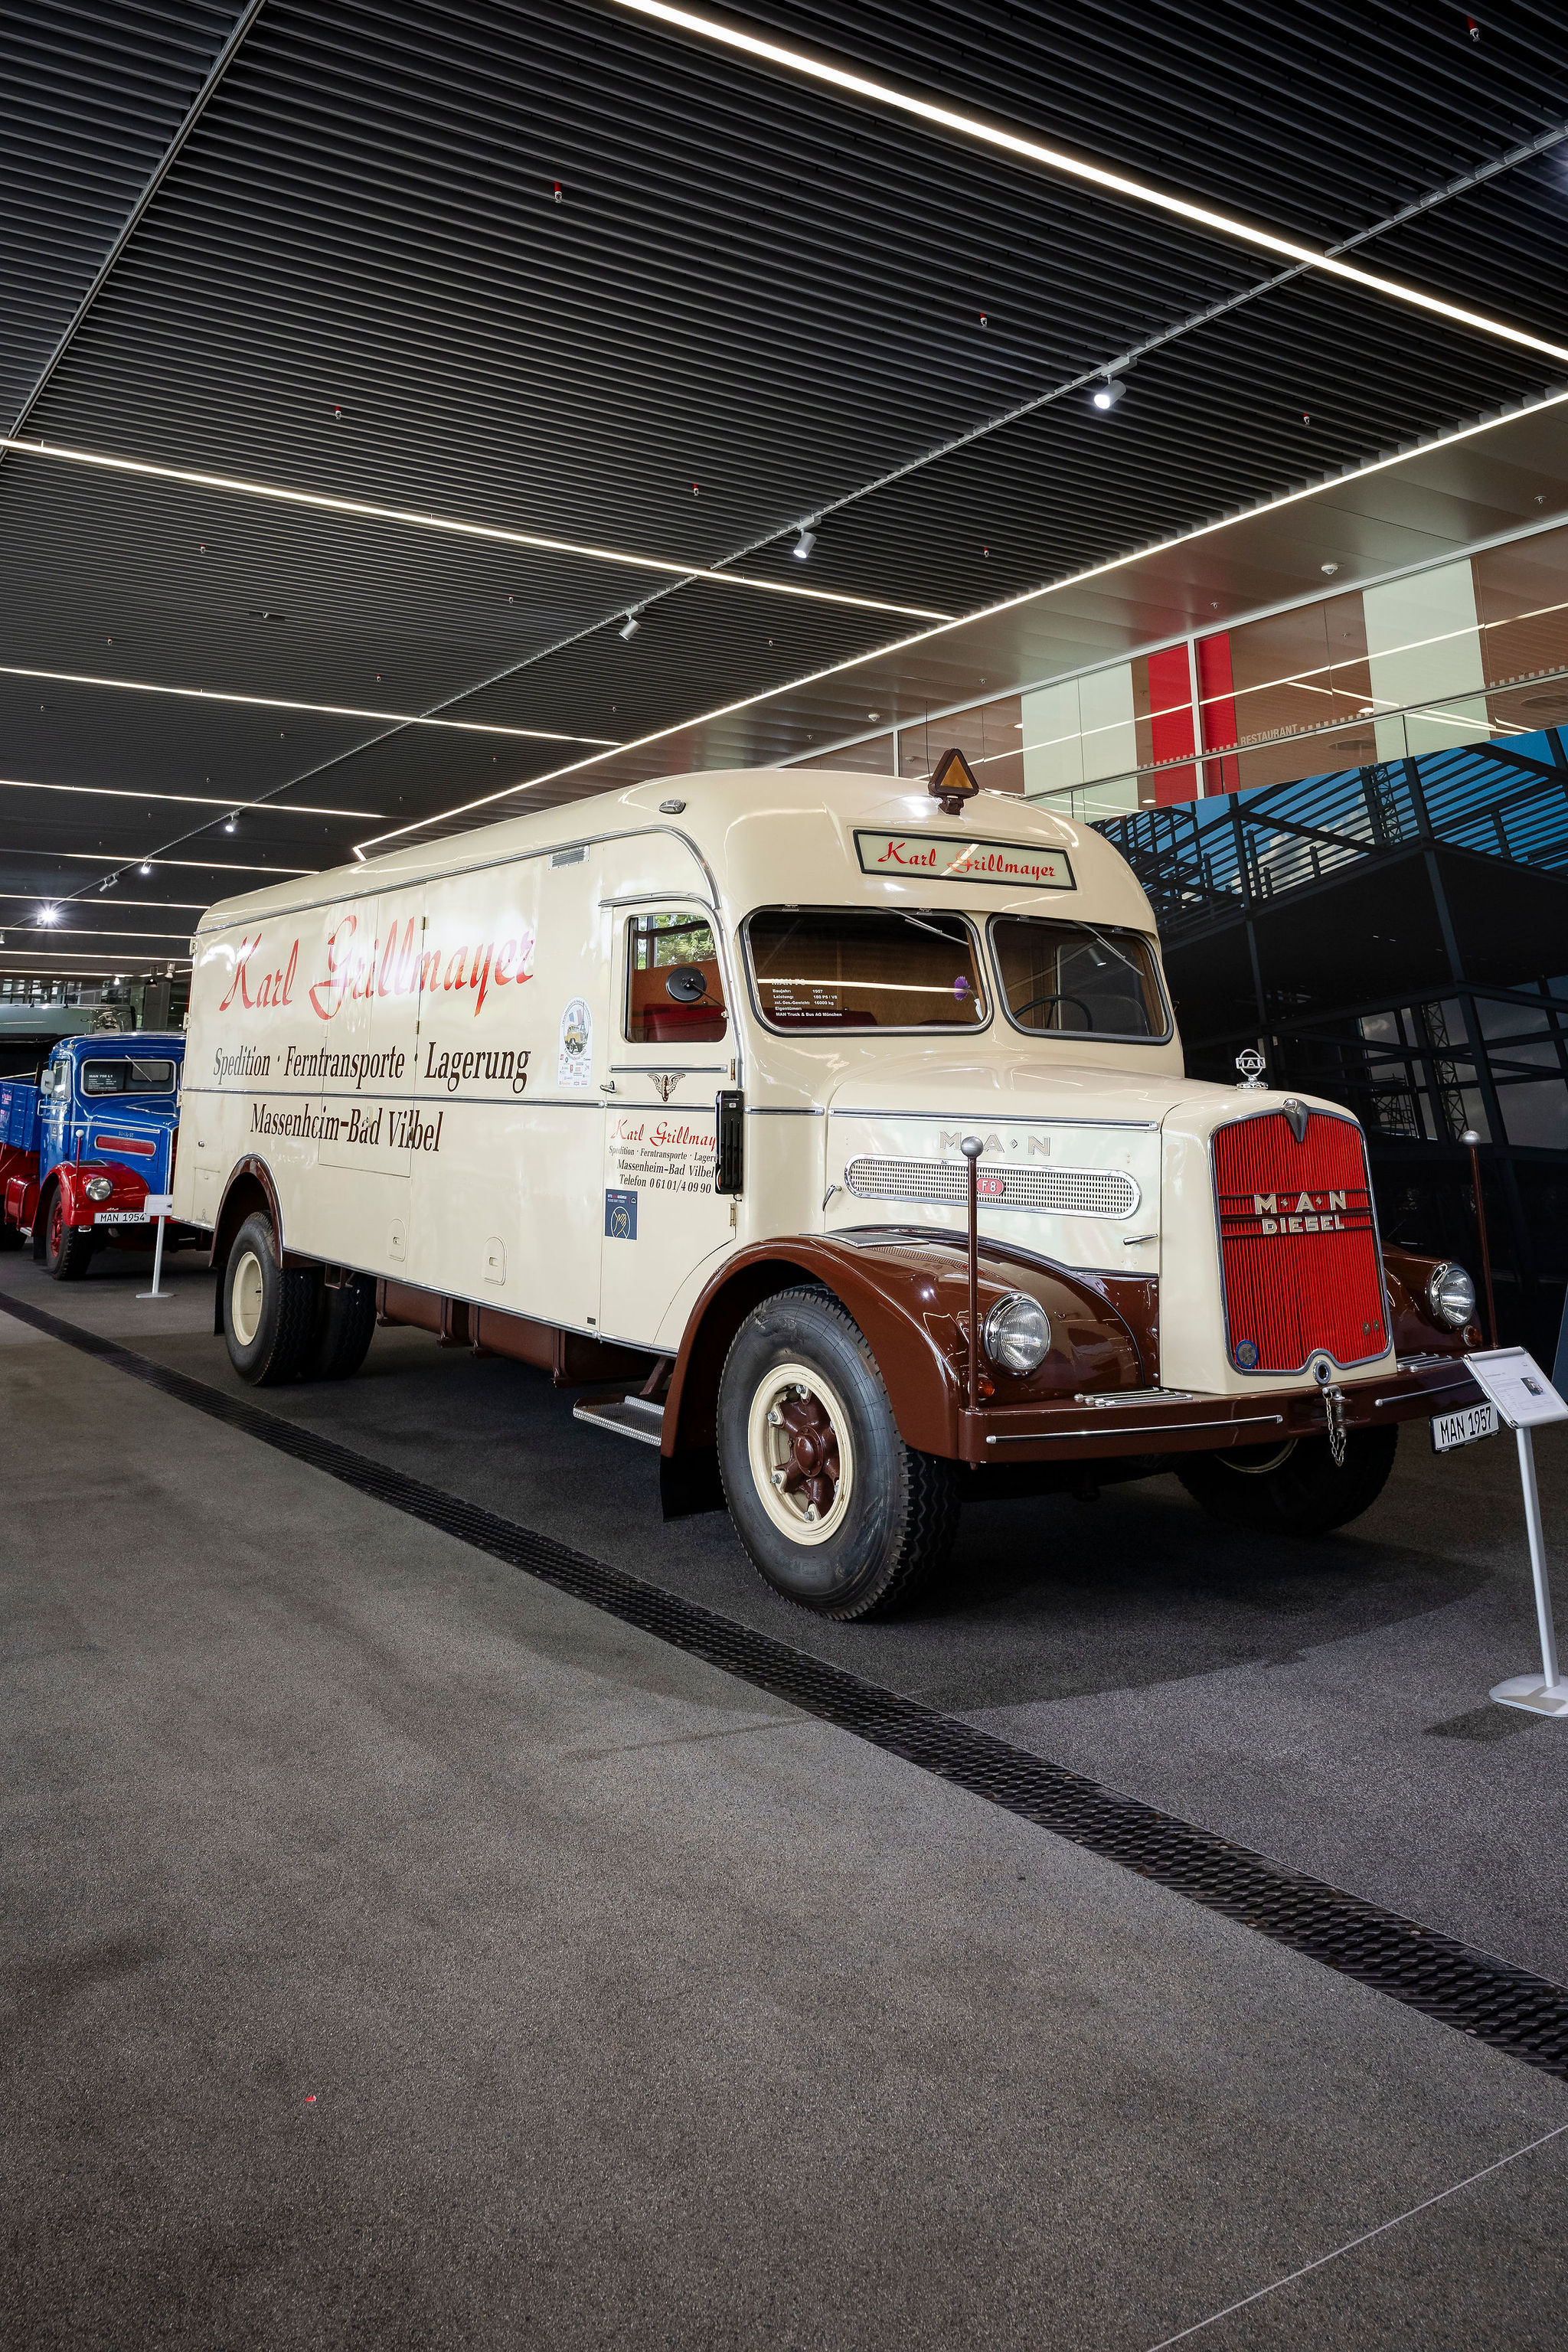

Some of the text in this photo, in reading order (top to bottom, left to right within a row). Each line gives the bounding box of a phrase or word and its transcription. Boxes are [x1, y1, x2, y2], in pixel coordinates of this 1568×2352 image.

[1240, 724, 1298, 746] RESTAURANT
[877, 841, 1056, 880] Karl Grillmayer
[219, 915, 534, 1021] Karl Grillmayer
[213, 1045, 271, 1085] Spedition
[283, 1044, 405, 1089] Ferntransporte
[424, 1041, 531, 1094] Lagerung
[1236, 1057, 1266, 1069] MAN
[250, 1102, 444, 1152] Massenheim-Bad Vilbel
[610, 1119, 716, 1152] Karl Grillmay
[608, 1145, 635, 1156] Spedition
[640, 1148, 688, 1161] Ferntransporte
[617, 1158, 714, 1178] Massenheim-Bad Vilbel
[619, 1174, 647, 1187] Telefon
[100, 1213, 145, 1223] MAN 1954
[1262, 1214, 1345, 1235] DIESEL
[1439, 1406, 1491, 1445] MAN 1957
